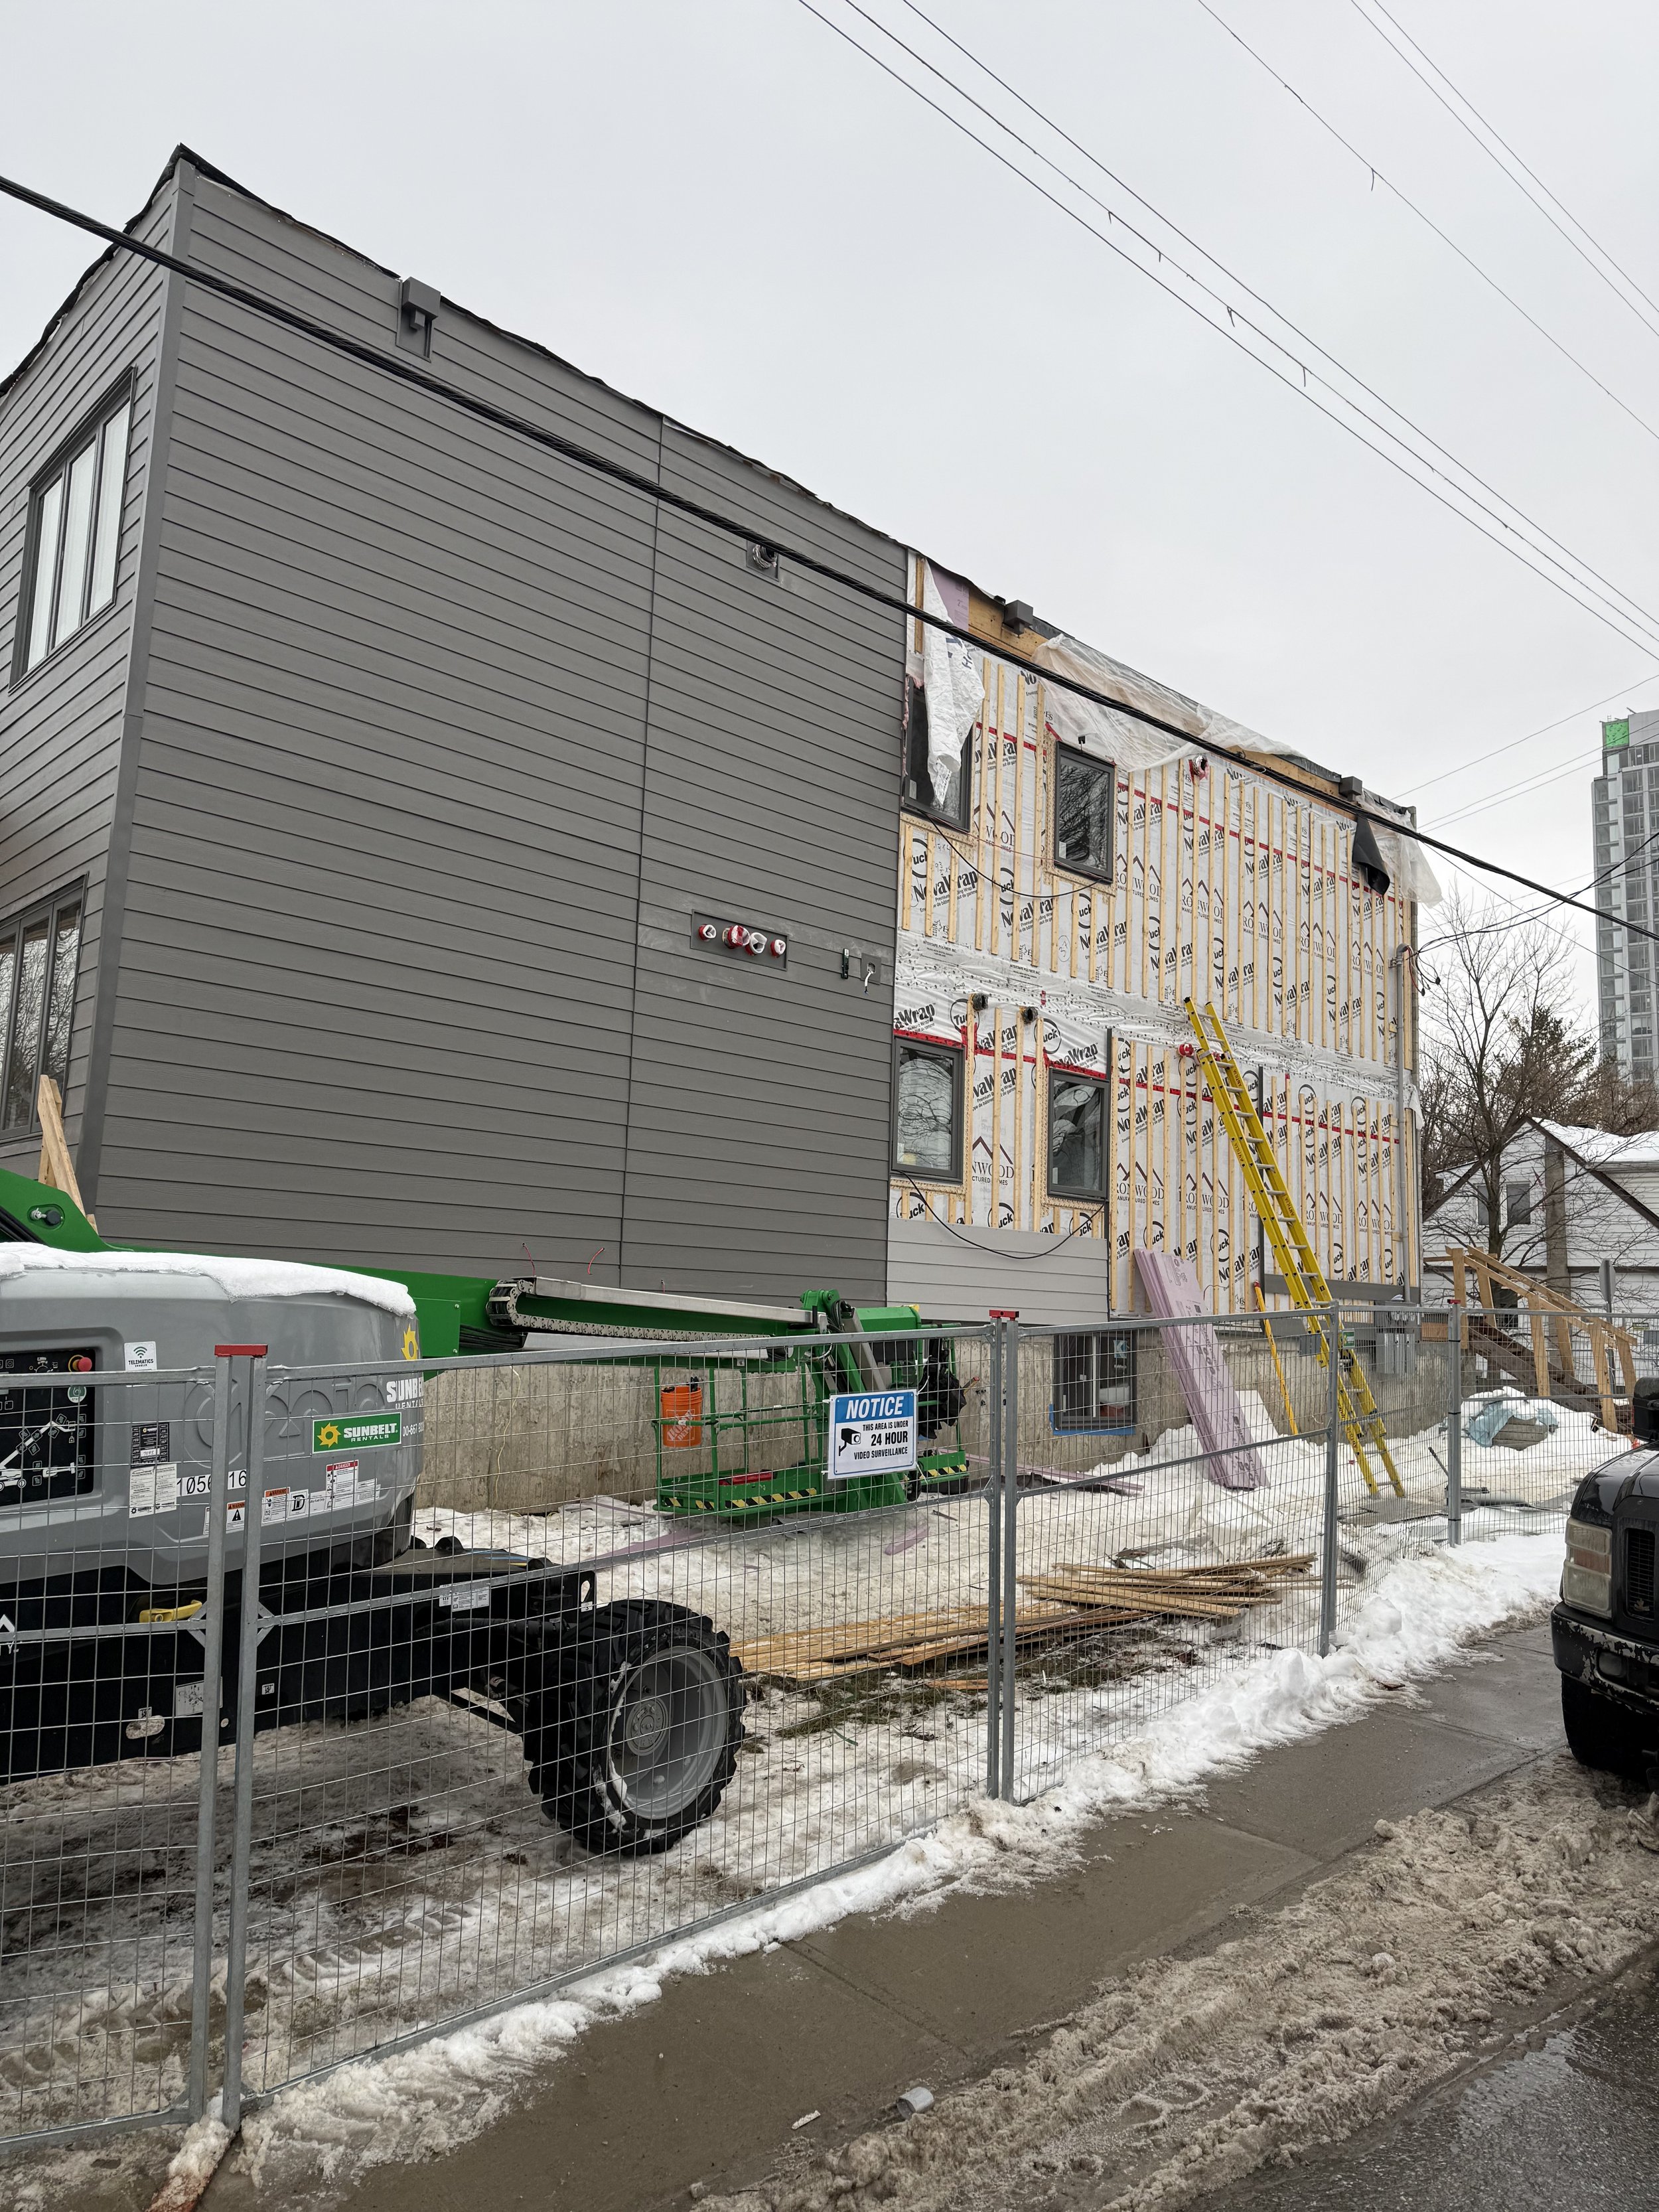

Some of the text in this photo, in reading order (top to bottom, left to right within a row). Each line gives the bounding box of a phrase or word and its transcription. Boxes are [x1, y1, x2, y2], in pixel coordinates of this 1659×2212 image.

[1043, 1029, 1059, 1043] uck
[1118, 1048, 1131, 1061] uck
[1248, 1079, 1258, 1092] uck
[1118, 1087, 1129, 1102] uck
[1305, 1092, 1315, 1105] uck
[1186, 1101, 1196, 1114] uck
[1357, 1104, 1366, 1116] uck
[999, 1213, 1013, 1228] uck
[1152, 1231, 1164, 1244] uck
[1218, 1238, 1230, 1252] uck
[1333, 1251, 1343, 1264] uck
[386, 1377, 423, 1403] SUNBE
[845, 1396, 904, 1420] NOTICE
[344, 1423, 397, 1439] SUNBELT
[871, 1431, 908, 1446] 24 HOUR
[854, 1447, 908, 1460] VIDEO SURVEILLANCE
